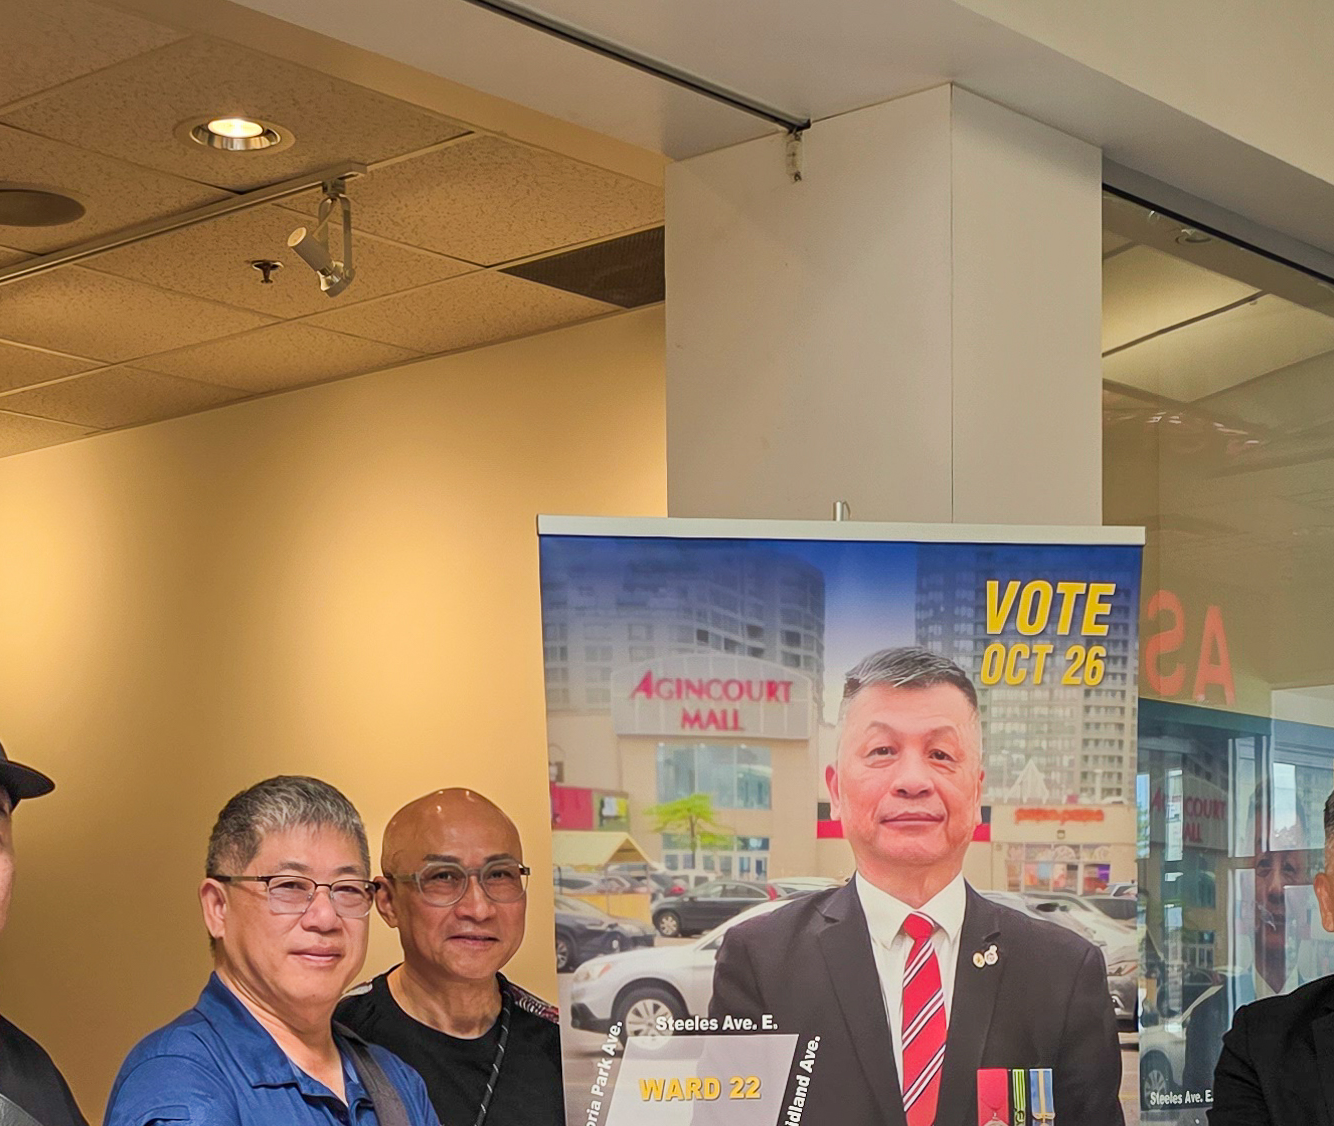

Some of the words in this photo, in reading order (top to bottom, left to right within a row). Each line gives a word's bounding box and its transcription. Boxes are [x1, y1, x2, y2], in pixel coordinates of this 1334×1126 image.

[985, 580, 1117, 637] VOTE
[980, 643, 1054, 686] OCT
[1061, 644, 1106, 686] 26
[630, 670, 793, 703] AGINCOURT
[680, 706, 745, 732] MALL
[601, 1021, 623, 1056] Ave.
[655, 1015, 718, 1032] Steeles
[722, 1015, 758, 1031] Ave.
[761, 1015, 778, 1030] E.
[799, 1036, 821, 1073] Ave.
[591, 1057, 613, 1097] Park
[638, 1076, 721, 1102] WARD
[729, 1076, 762, 1100] 22
[1150, 1090, 1183, 1106] Steeles
[1185, 1090, 1203, 1104] Ave.
